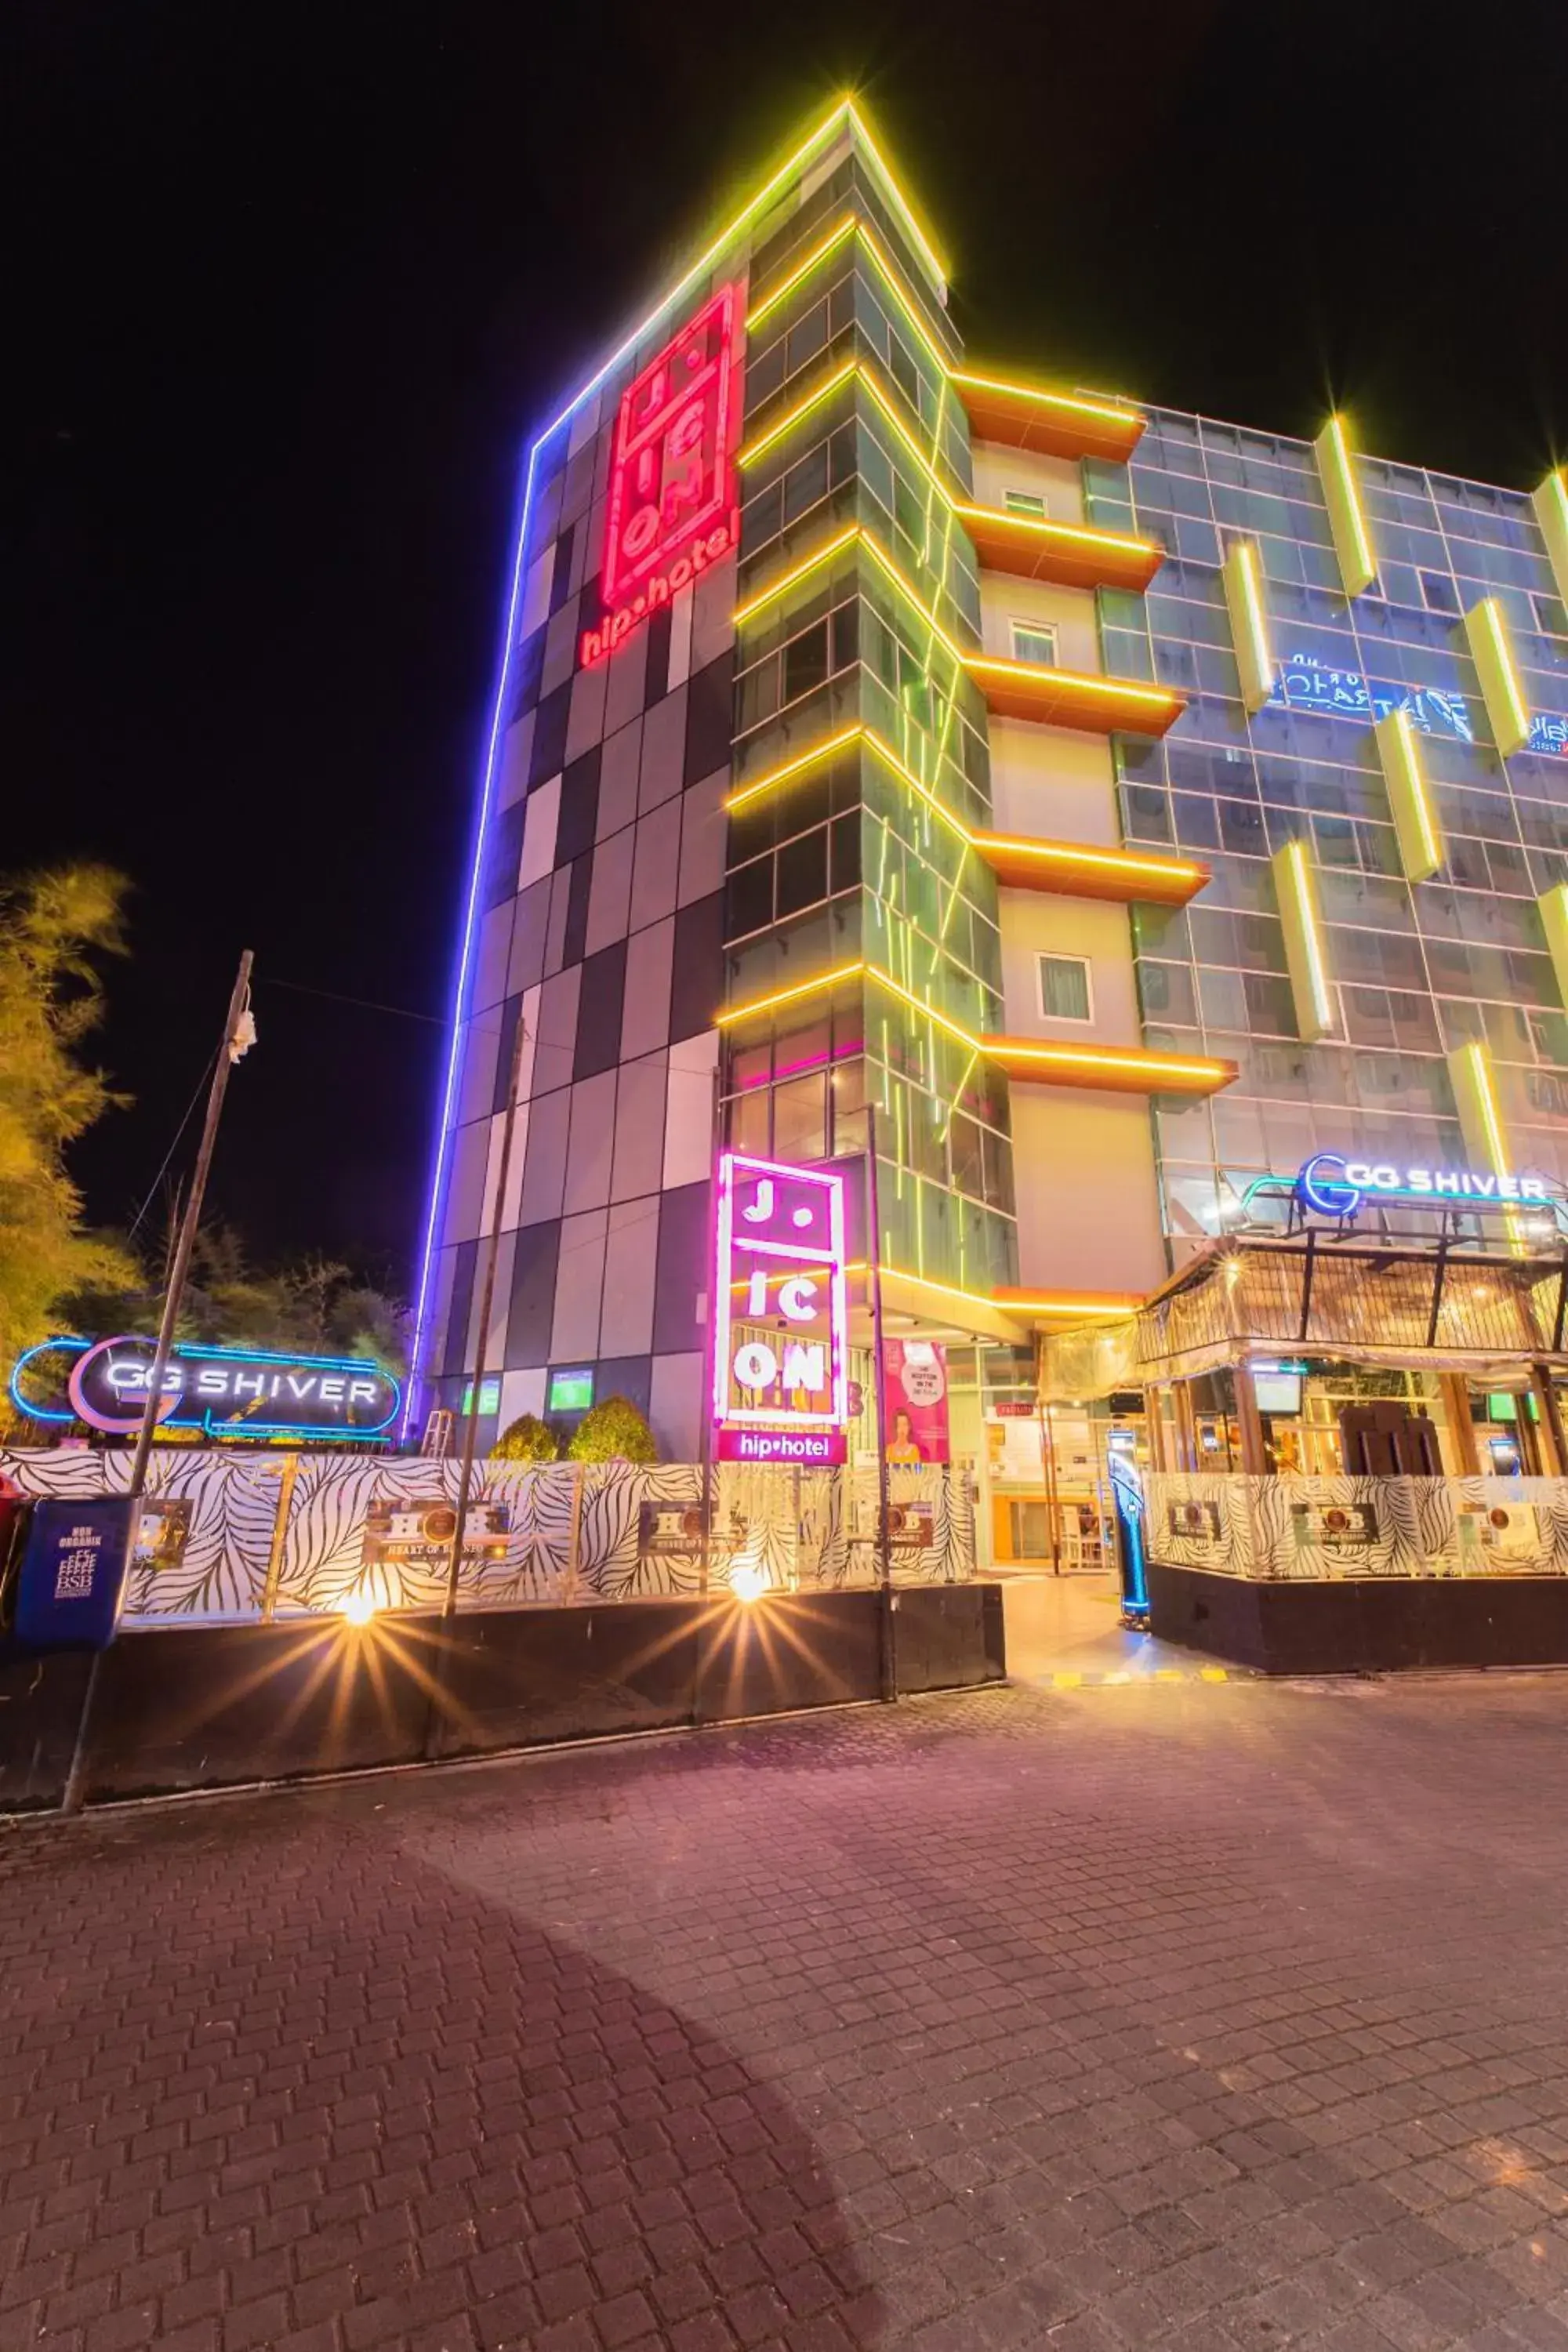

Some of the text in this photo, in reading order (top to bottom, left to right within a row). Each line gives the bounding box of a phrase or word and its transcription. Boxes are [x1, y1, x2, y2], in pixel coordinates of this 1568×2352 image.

[1406, 1169, 1546, 1200] SHIVER
[749, 1271, 818, 1320] IC
[734, 1343, 824, 1391] ON
[197, 1370, 378, 1403] SHIVER
[387, 1544, 423, 1555] HEART
[442, 1544, 485, 1555] BNEO
[57, 1574, 93, 1589] BSB
